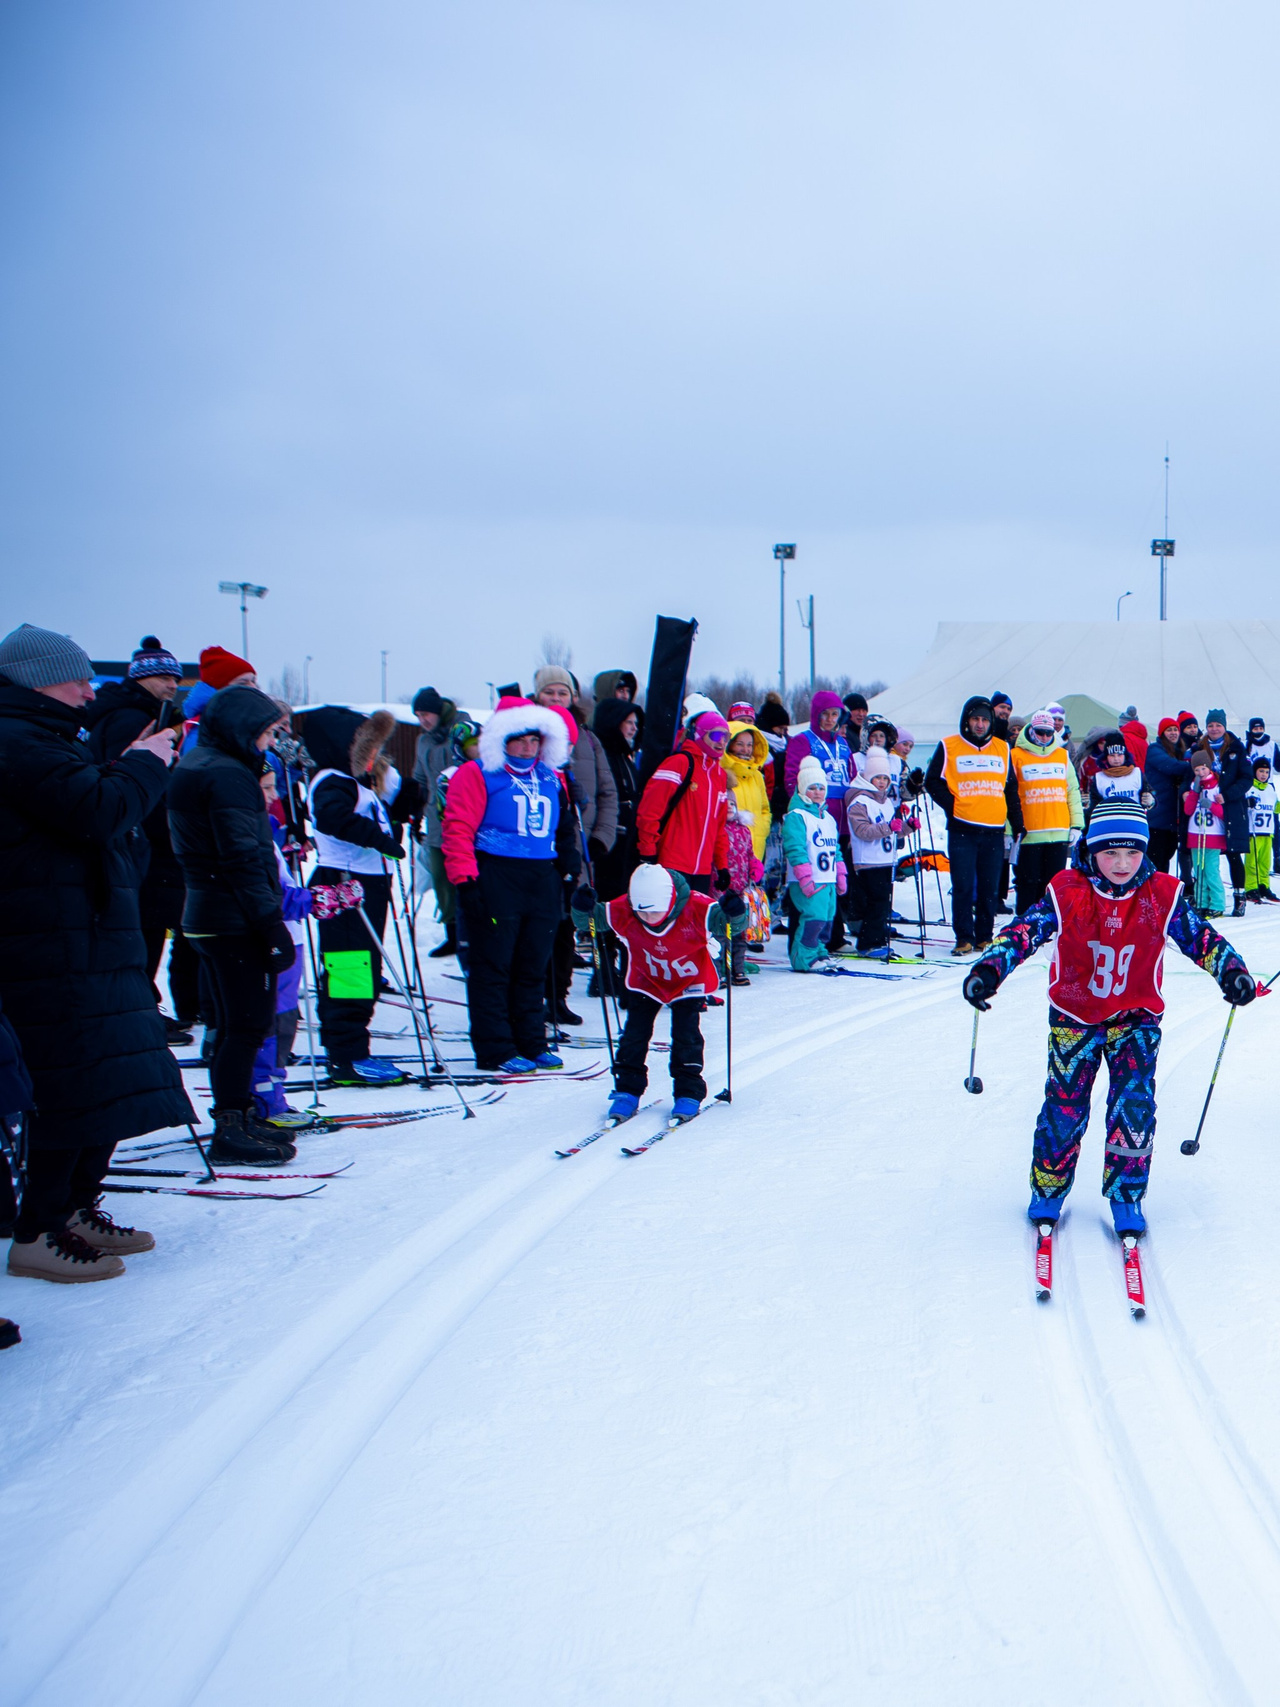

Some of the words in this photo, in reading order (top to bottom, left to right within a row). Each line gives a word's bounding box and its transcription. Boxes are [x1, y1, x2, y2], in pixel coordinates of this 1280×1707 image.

[1193, 810, 1214, 828] 68
[1254, 812, 1273, 828] 57
[816, 851, 837, 872] 67
[642, 948, 699, 981] 176
[1037, 1253, 1050, 1280] NORDWAY
[1126, 1267, 1141, 1295] NORDWAY
